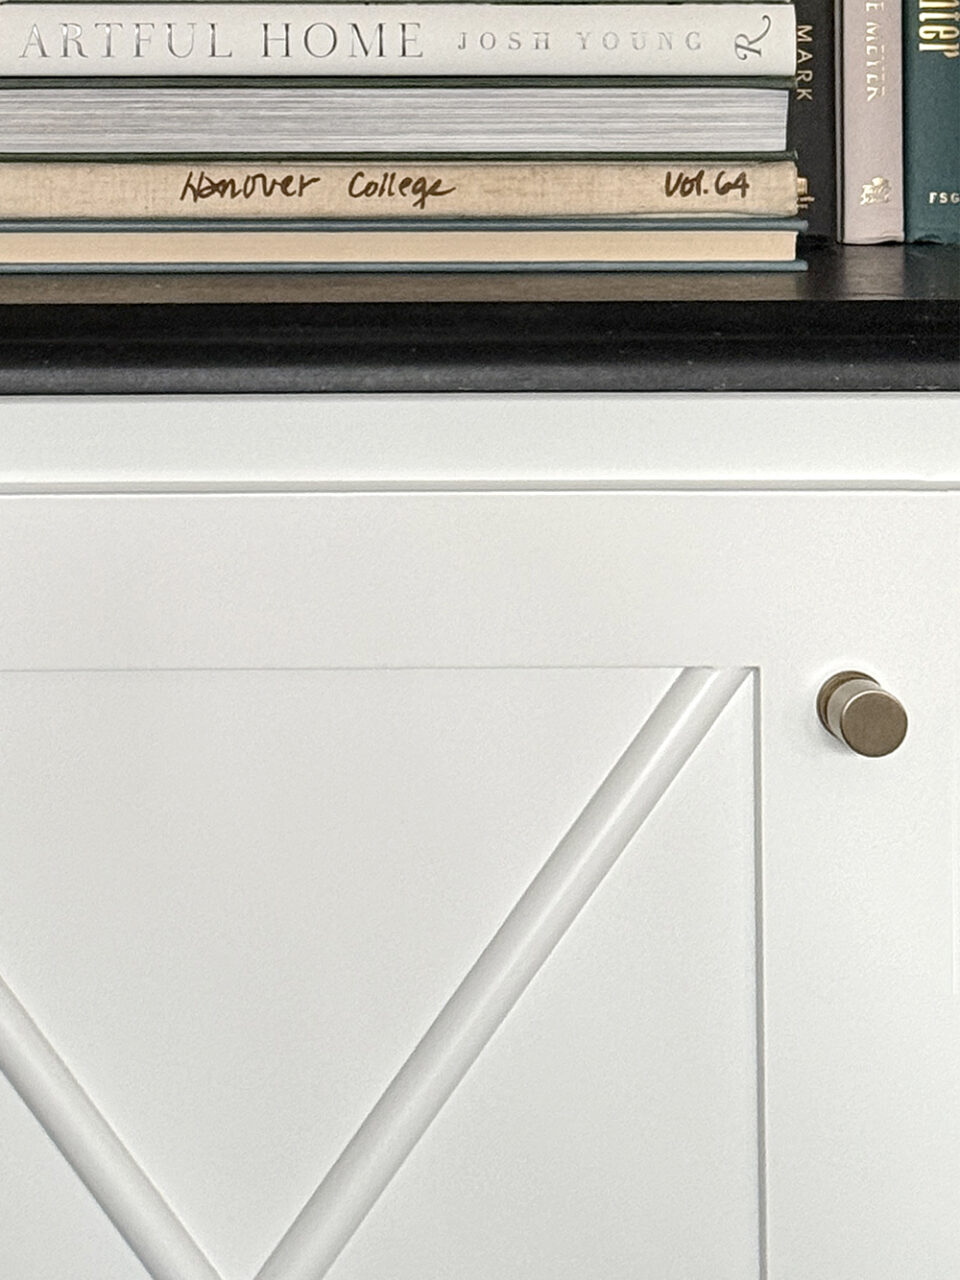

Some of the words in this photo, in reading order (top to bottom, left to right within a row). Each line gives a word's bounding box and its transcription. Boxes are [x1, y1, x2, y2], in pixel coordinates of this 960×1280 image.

[18, 22, 233, 59] ARTFUL
[262, 22, 424, 59] HOME
[457, 31, 551, 51] JOSH
[576, 31, 703, 51] YOUNG
[796, 24, 814, 102] MARK
[180, 170, 321, 203] Hanover
[347, 171, 457, 209] College
[664, 170, 709, 197] Vol.
[715, 170, 751, 198] 64
